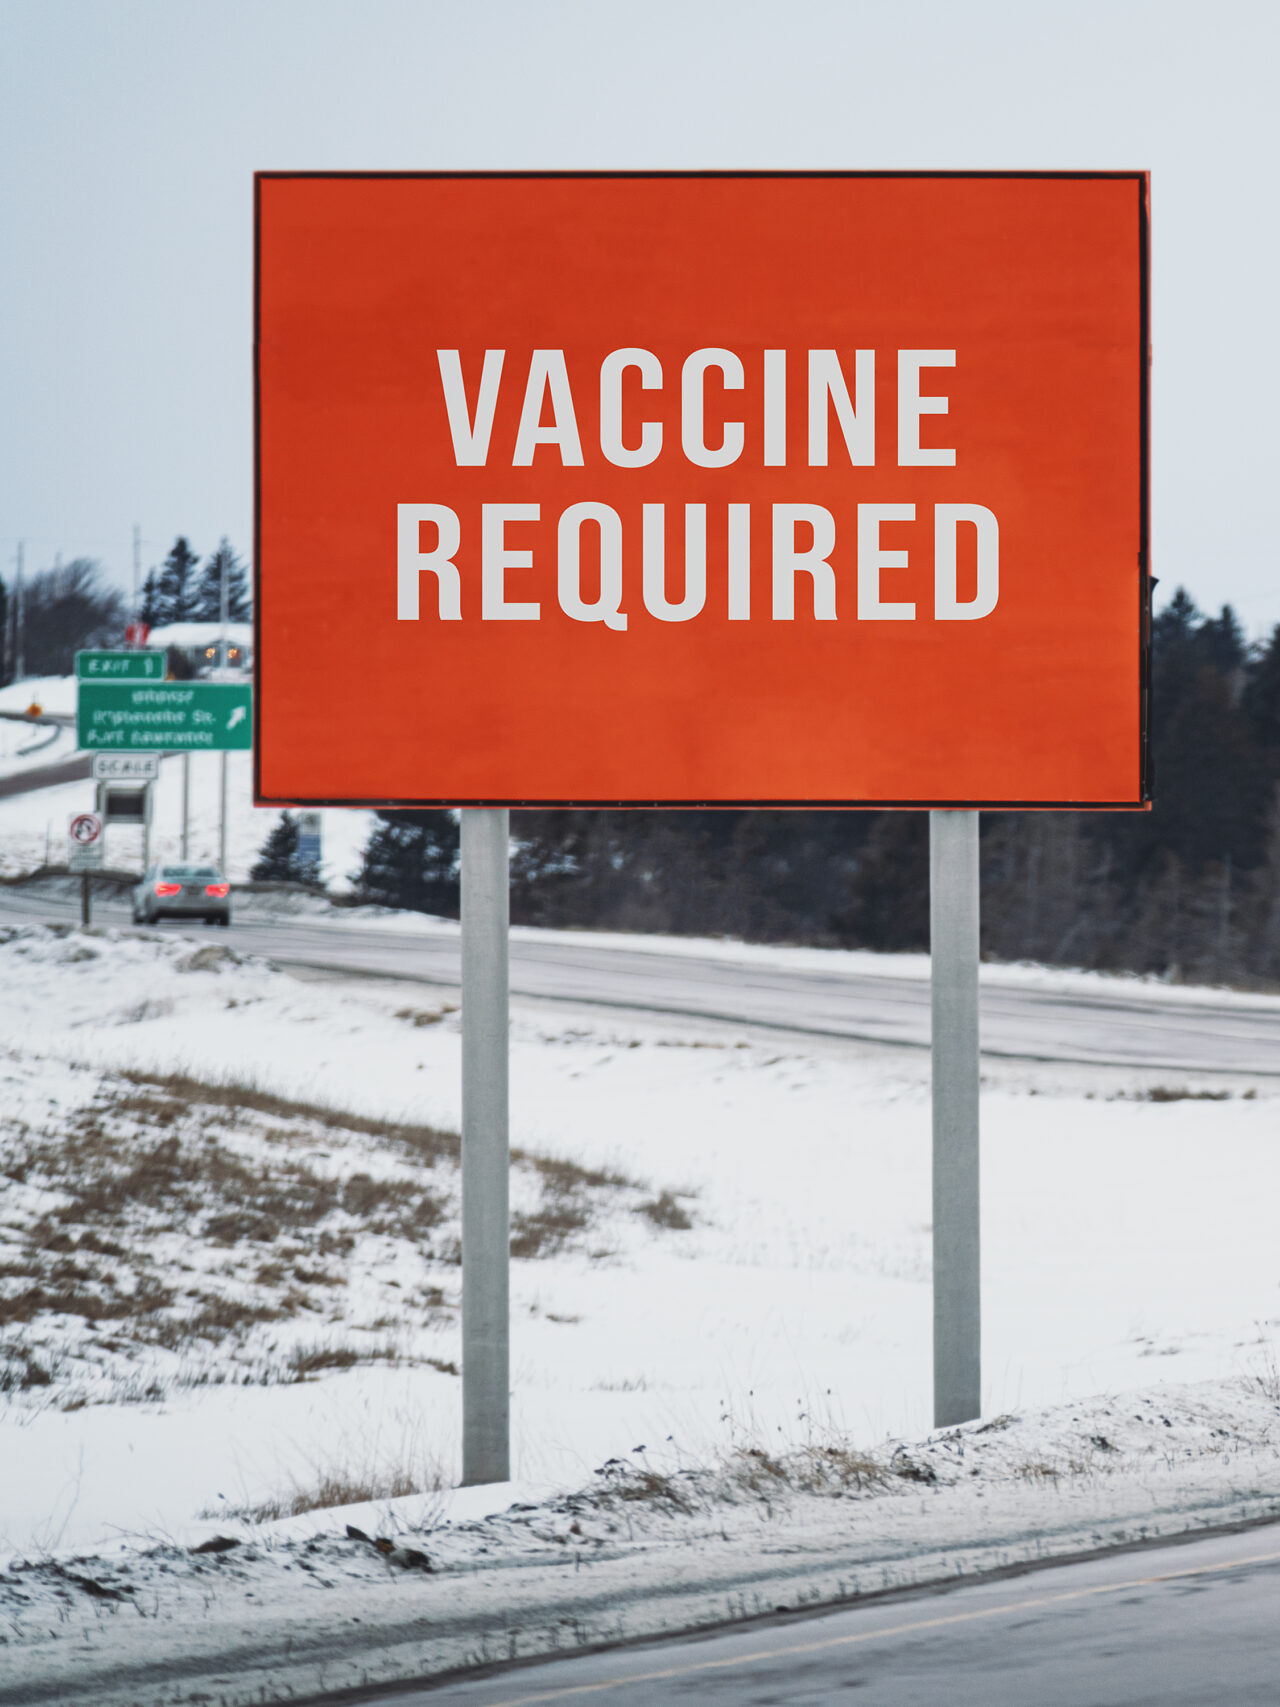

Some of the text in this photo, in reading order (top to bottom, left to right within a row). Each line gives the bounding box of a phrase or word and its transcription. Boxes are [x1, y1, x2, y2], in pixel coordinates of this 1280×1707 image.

[437, 347, 956, 468] VACCINE
[397, 502, 999, 631] REQUIRED
[88, 659, 130, 674] EXIT
[97, 760, 154, 776] SCALE
